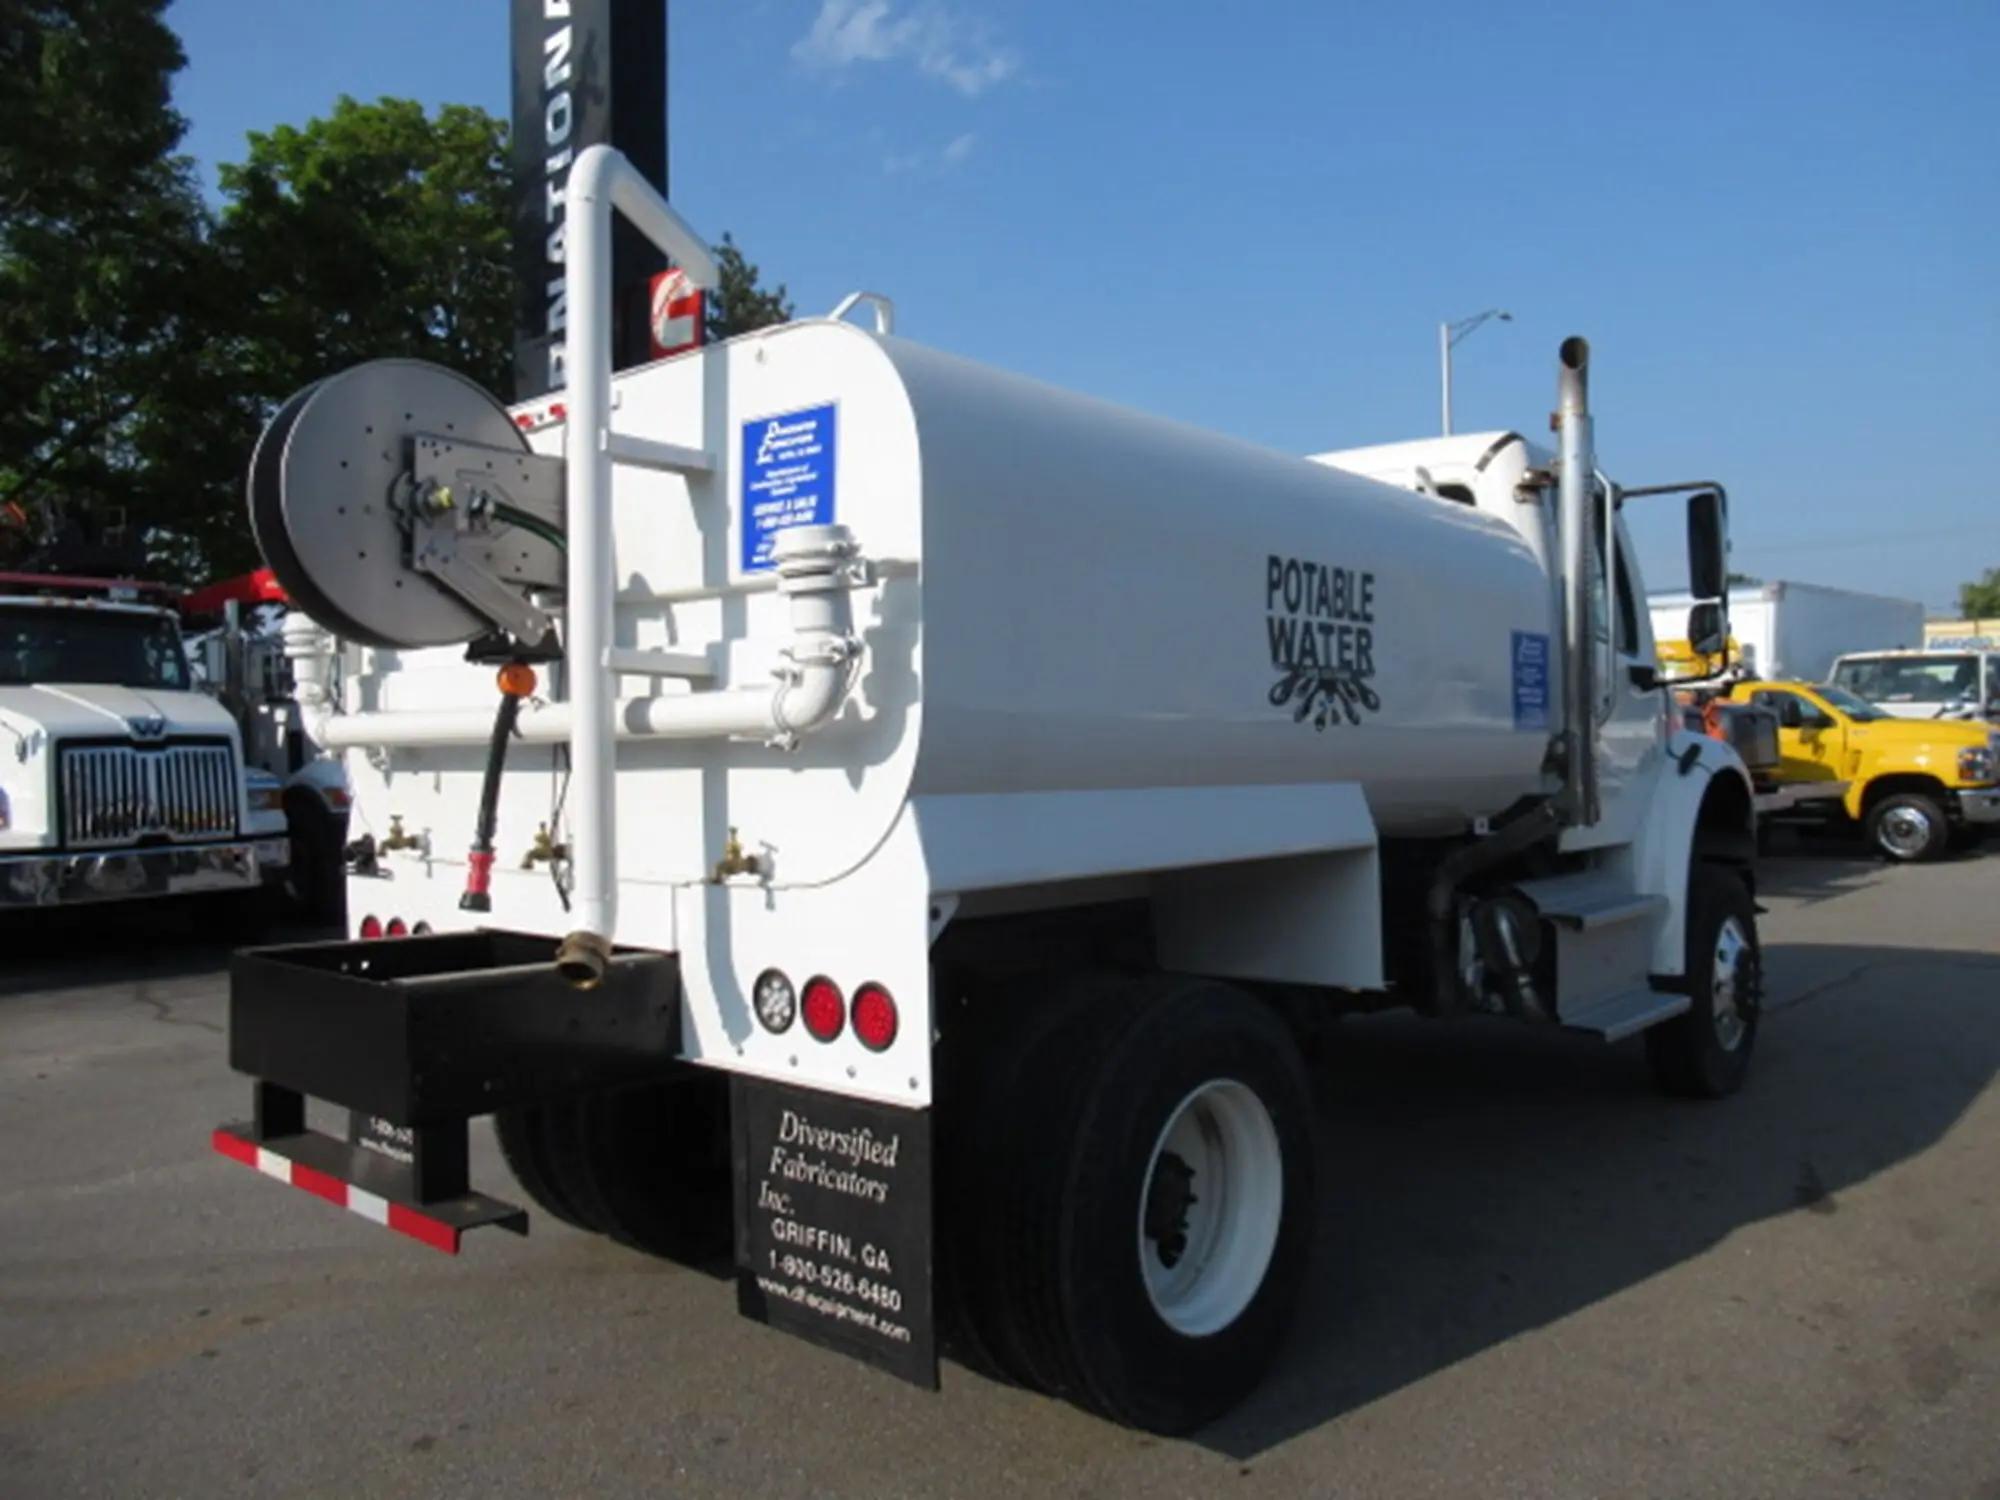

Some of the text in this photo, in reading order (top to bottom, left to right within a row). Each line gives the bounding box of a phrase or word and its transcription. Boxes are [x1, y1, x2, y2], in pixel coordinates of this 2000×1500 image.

[1267, 554, 1375, 622] POTABLE
[1267, 617, 1376, 677] WATER
[778, 1110, 898, 1167] Diversified
[758, 1180, 796, 1215] Inc.
[769, 1146, 888, 1204] Fabricators
[861, 1242, 892, 1274] GA
